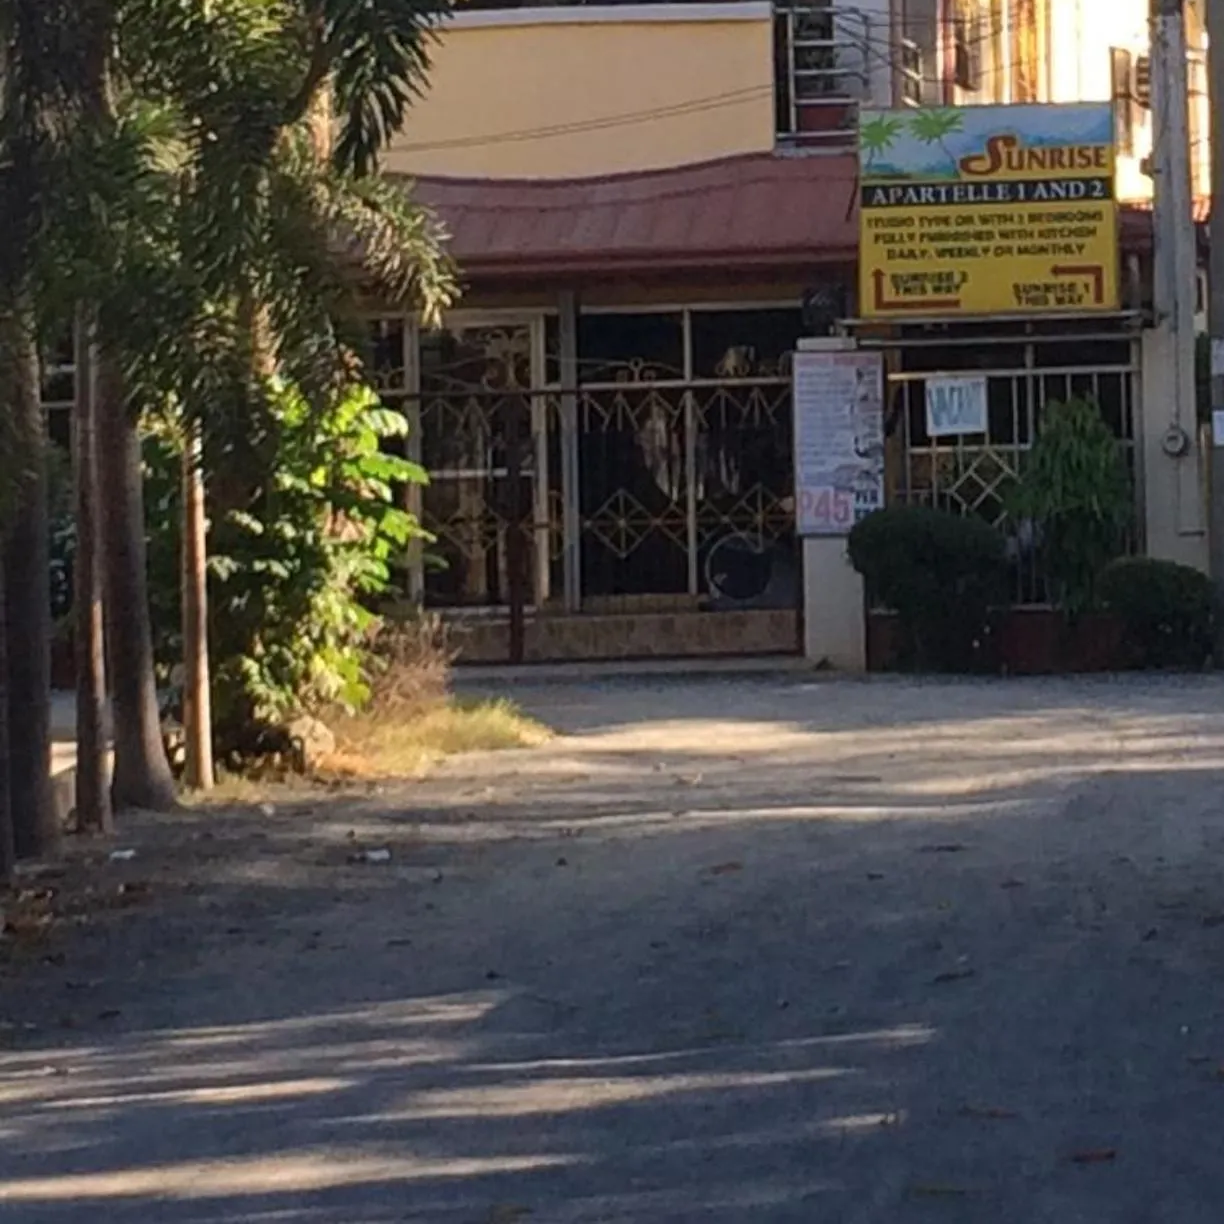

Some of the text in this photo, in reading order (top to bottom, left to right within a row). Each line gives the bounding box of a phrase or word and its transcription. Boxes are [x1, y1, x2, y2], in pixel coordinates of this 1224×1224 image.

[960, 135, 1106, 175] SUNRISE
[872, 184, 1010, 206] APARTELLE
[1032, 181, 1085, 199] AND
[1092, 180, 1105, 197] 2
[919, 215, 951, 228] TYPE
[955, 214, 975, 226] OR
[979, 213, 1014, 225] WITH
[874, 226, 1097, 245] FULLY FURNISHED WITH KITCHEN
[936, 245, 990, 258] WEEKLY
[994, 244, 1014, 257] OR
[1017, 242, 1085, 256] MONTHLY
[894, 283, 961, 296] THIS WAY
[1012, 282, 1077, 294] SUNRISE
[1014, 292, 1084, 307] THIS WAY
